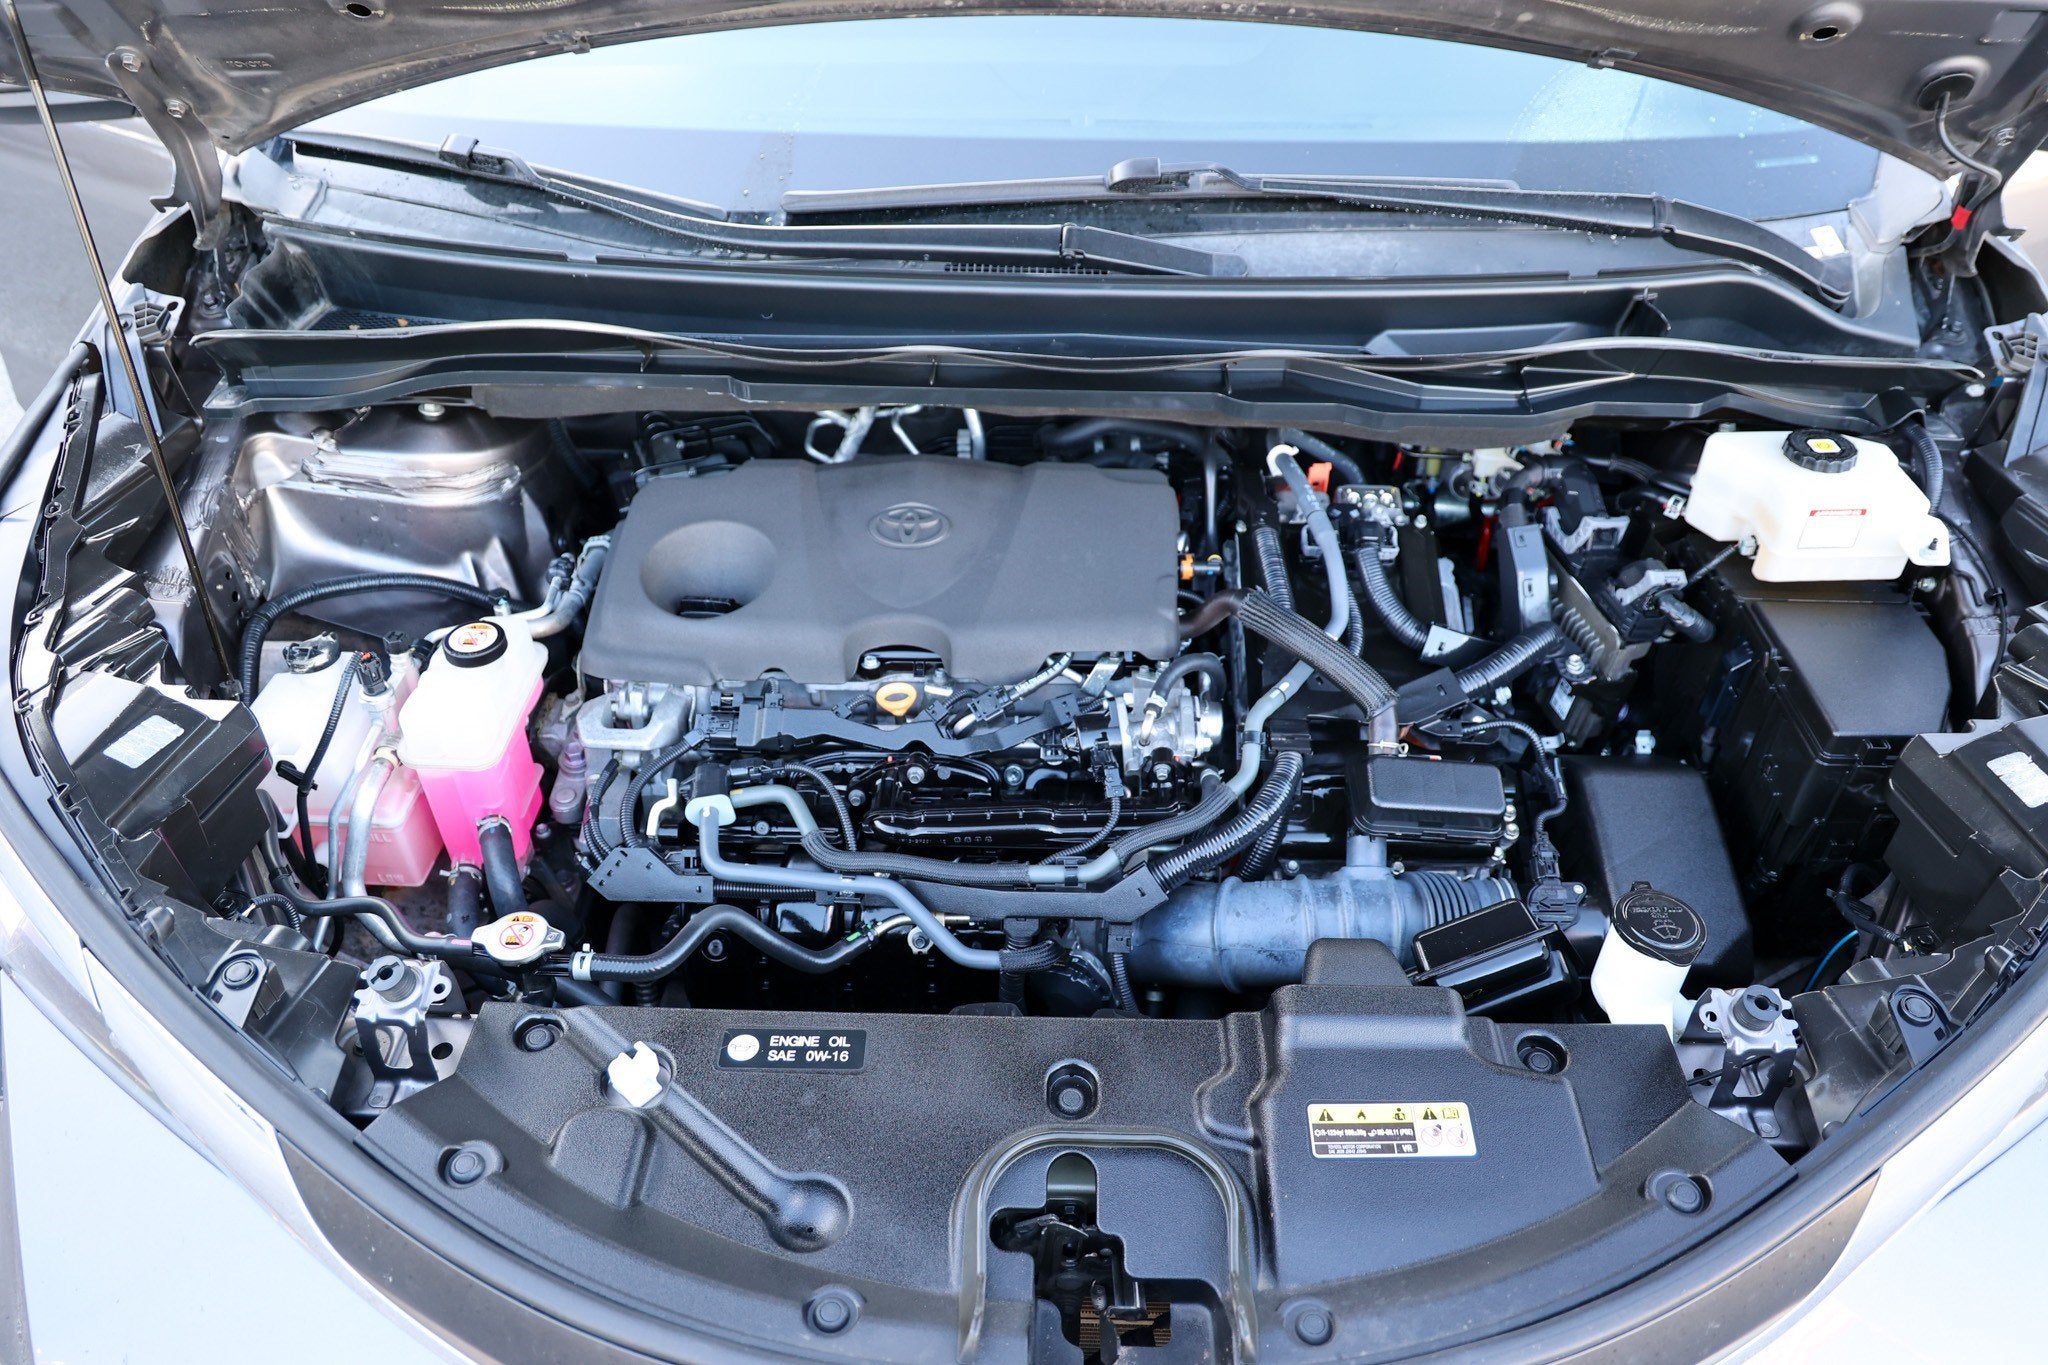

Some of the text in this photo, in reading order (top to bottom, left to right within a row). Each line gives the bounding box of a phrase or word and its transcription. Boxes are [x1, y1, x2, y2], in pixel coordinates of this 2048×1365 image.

[224, 60, 272, 68] TOYOTA
[377, 873, 404, 883] LOW
[770, 1035, 851, 1047] ENGINE OIL
[767, 1050, 849, 1062] SAE 0W-16
